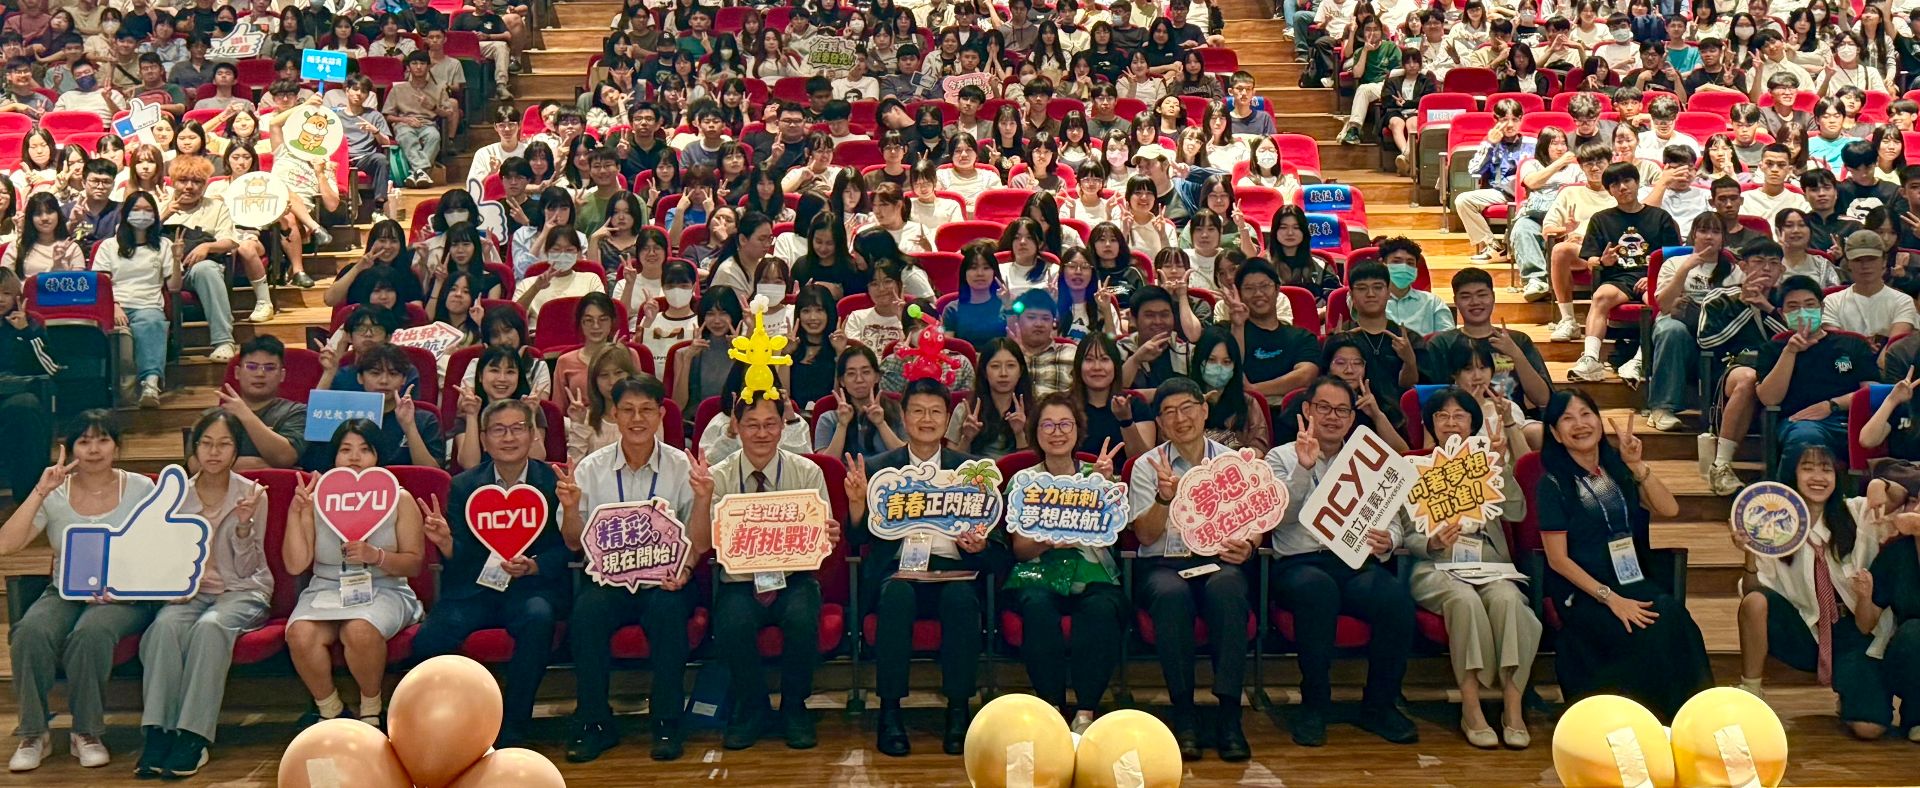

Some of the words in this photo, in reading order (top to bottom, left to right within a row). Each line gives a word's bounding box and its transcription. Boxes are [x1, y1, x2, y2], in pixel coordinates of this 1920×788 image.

[45, 276, 90, 292] 特教系
[886, 491, 995, 520] 青春正閃耀！
[1195, 484, 1280, 547] 現在出發！
[1341, 466, 1399, 548] 國立嘉義大學
[1372, 507, 1386, 527] CHIAYI
[1384, 477, 1406, 509] UNIVERSITY
[601, 542, 678, 574] 現在開始！
[726, 522, 821, 558] 新挑戰！
